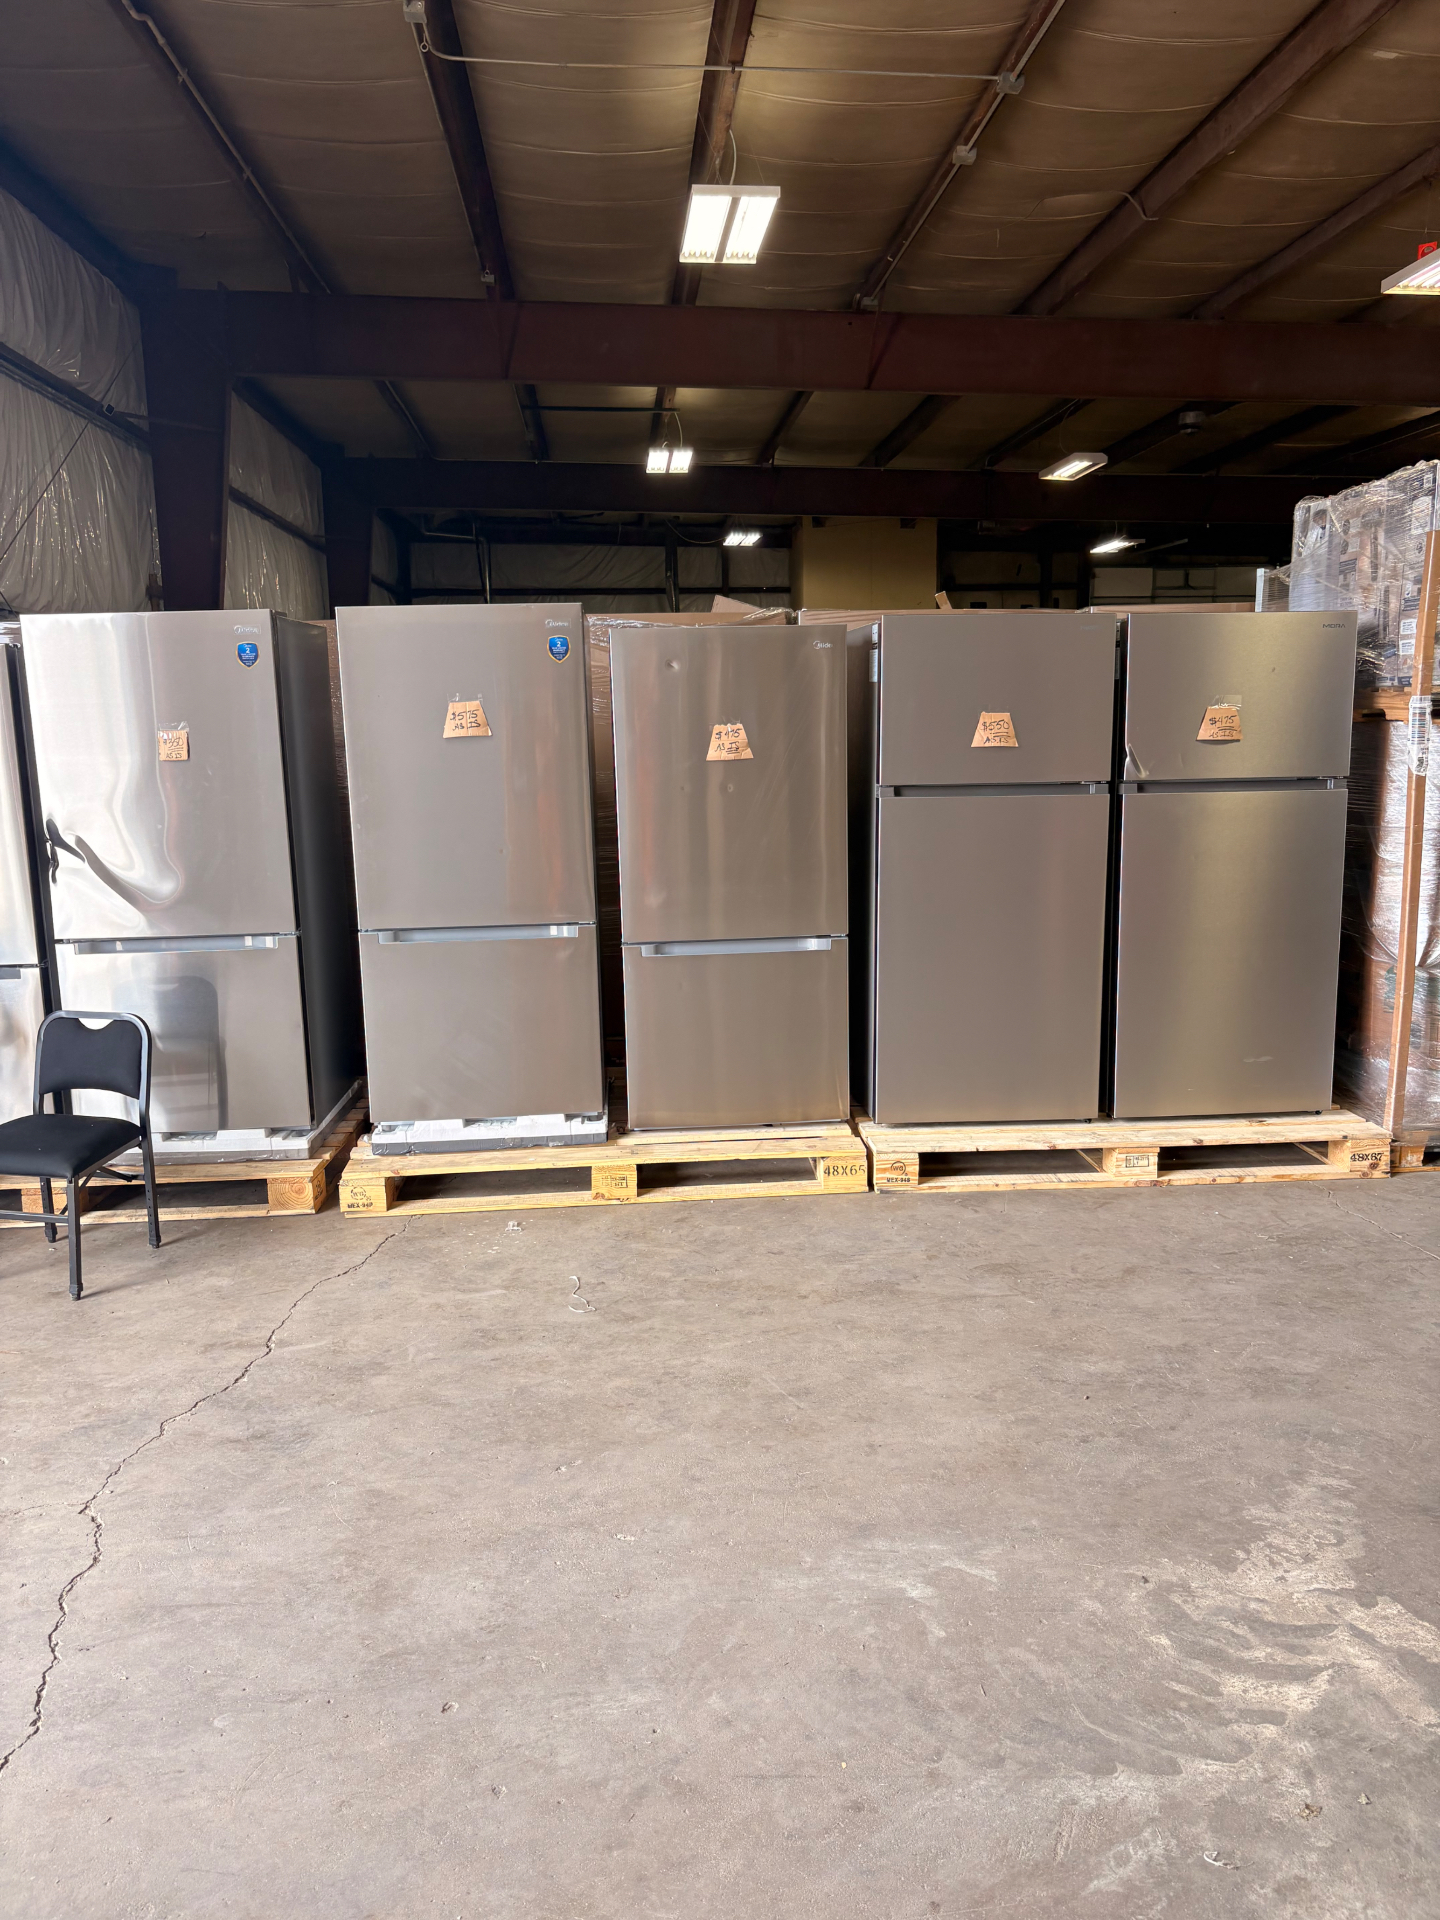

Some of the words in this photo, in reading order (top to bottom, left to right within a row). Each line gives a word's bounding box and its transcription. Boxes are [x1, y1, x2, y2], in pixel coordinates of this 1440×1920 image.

[813, 640, 834, 649] Mide
[450, 709, 480, 721] $575
[1209, 715, 1237, 727] $475
[982, 719, 1010, 732] $550
[1350, 1153, 1384, 1162] 48X67
[823, 1164, 866, 1177] 48X65
